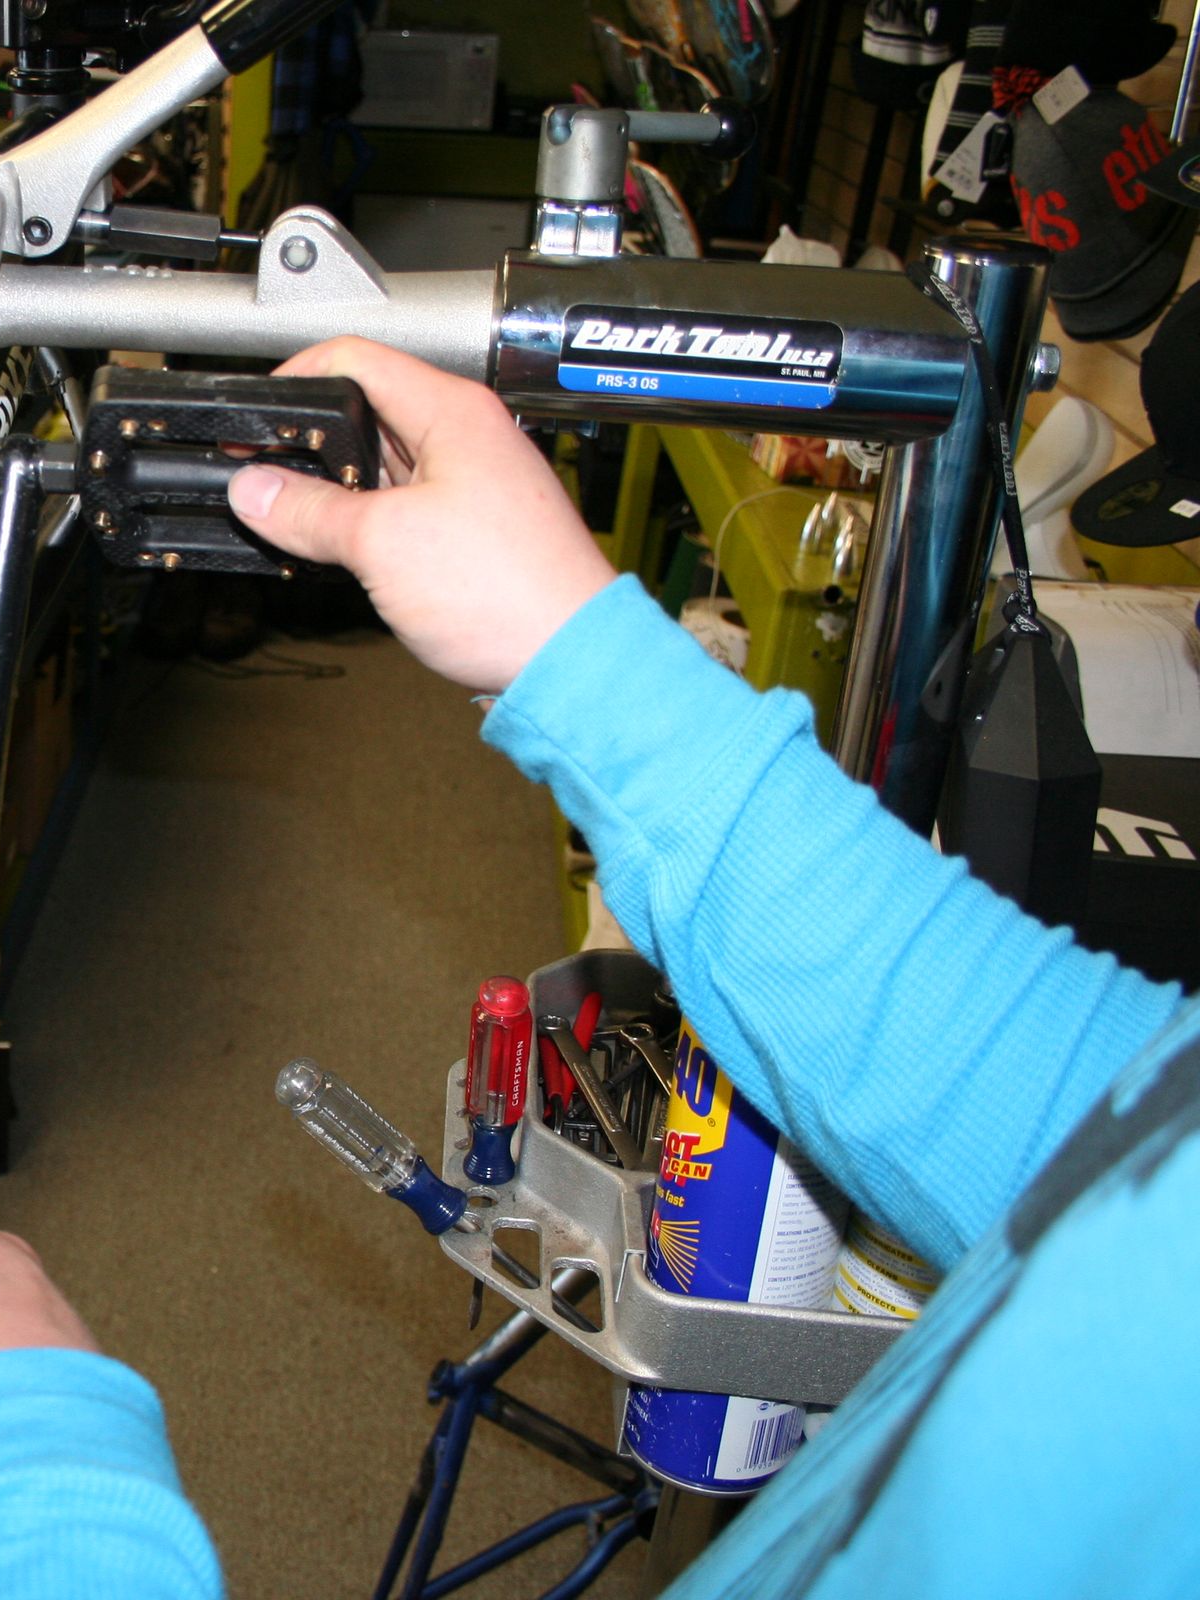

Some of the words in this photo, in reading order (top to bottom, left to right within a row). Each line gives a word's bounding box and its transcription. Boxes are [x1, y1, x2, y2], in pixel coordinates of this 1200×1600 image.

[570, 320, 681, 356] Park
[684, 327, 791, 364] Tool
[596, 373, 637, 389] PRS-3
[640, 377, 659, 391] OS
[511, 1040, 524, 1107] CRAFTSMAN
[670, 1160, 708, 1178] CAN
[665, 1189, 686, 1208] fast
[866, 1259, 899, 1281] CLEANS
[856, 1285, 897, 1312] PROTECTS
